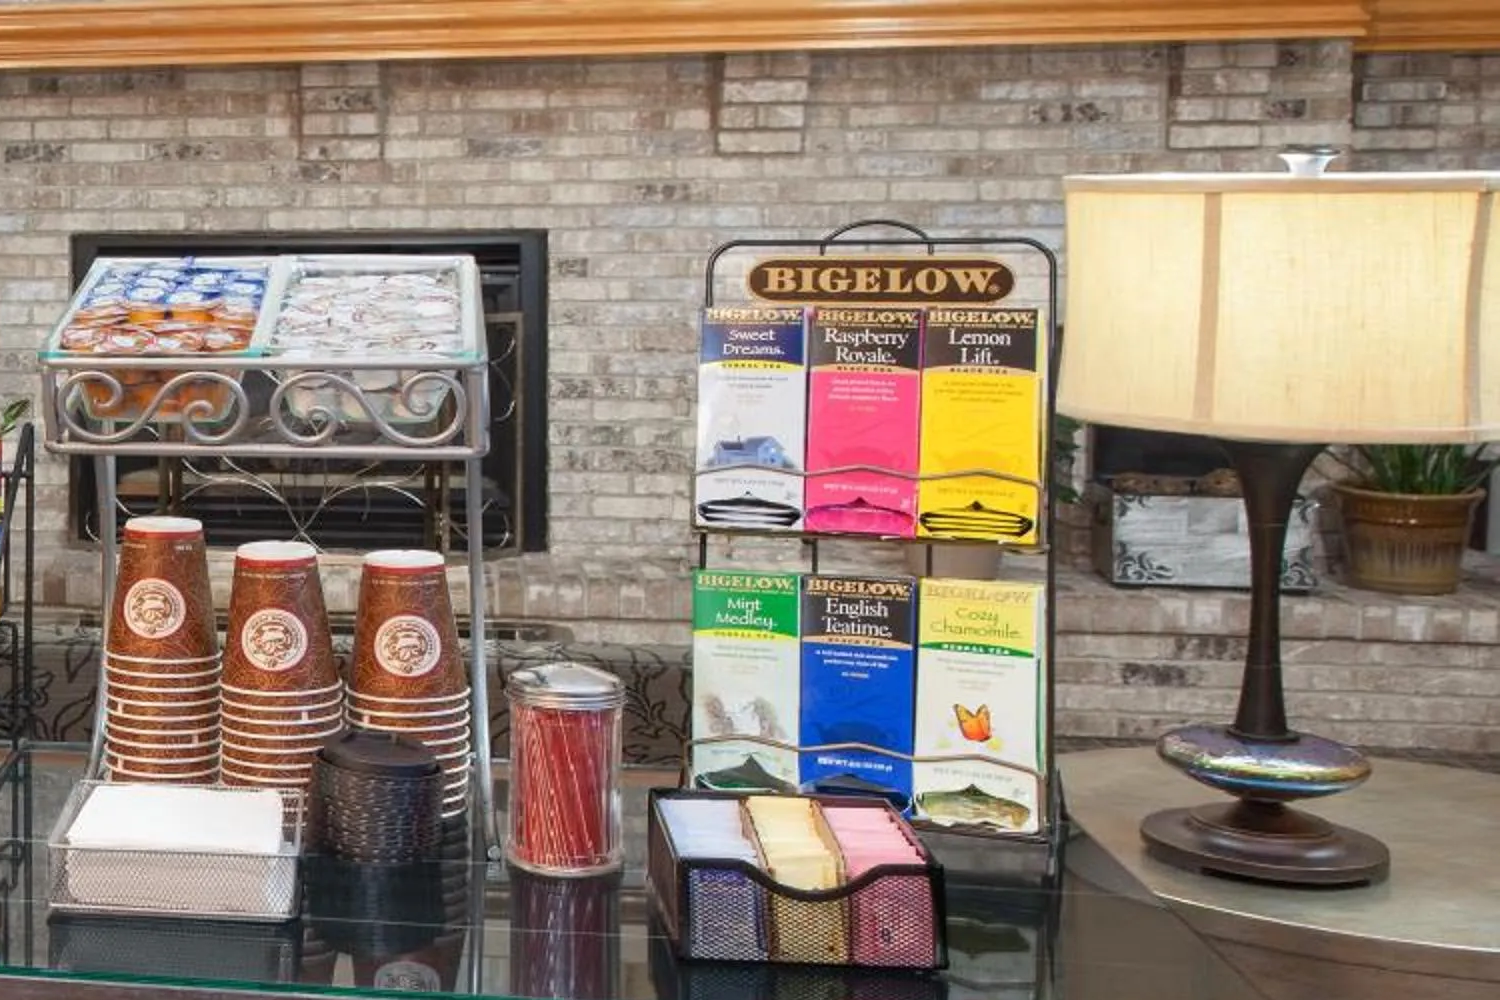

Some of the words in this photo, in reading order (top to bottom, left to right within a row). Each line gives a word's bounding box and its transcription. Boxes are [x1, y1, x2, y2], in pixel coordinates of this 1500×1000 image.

[763, 267, 1000, 294] BIGELOW
[818, 309, 917, 323] BIGELOW
[928, 310, 1034, 325] BIGELOW
[728, 328, 776, 341] Sweet
[824, 327, 909, 349] Raspberry
[948, 327, 1011, 346] Lemon
[698, 574, 794, 590] BIGELOW
[807, 579, 907, 597] BIGELOW
[727, 597, 762, 611] Mint
[826, 597, 888, 618] English
[955, 607, 999, 626] Cozy
[821, 615, 889, 637] Teatime
